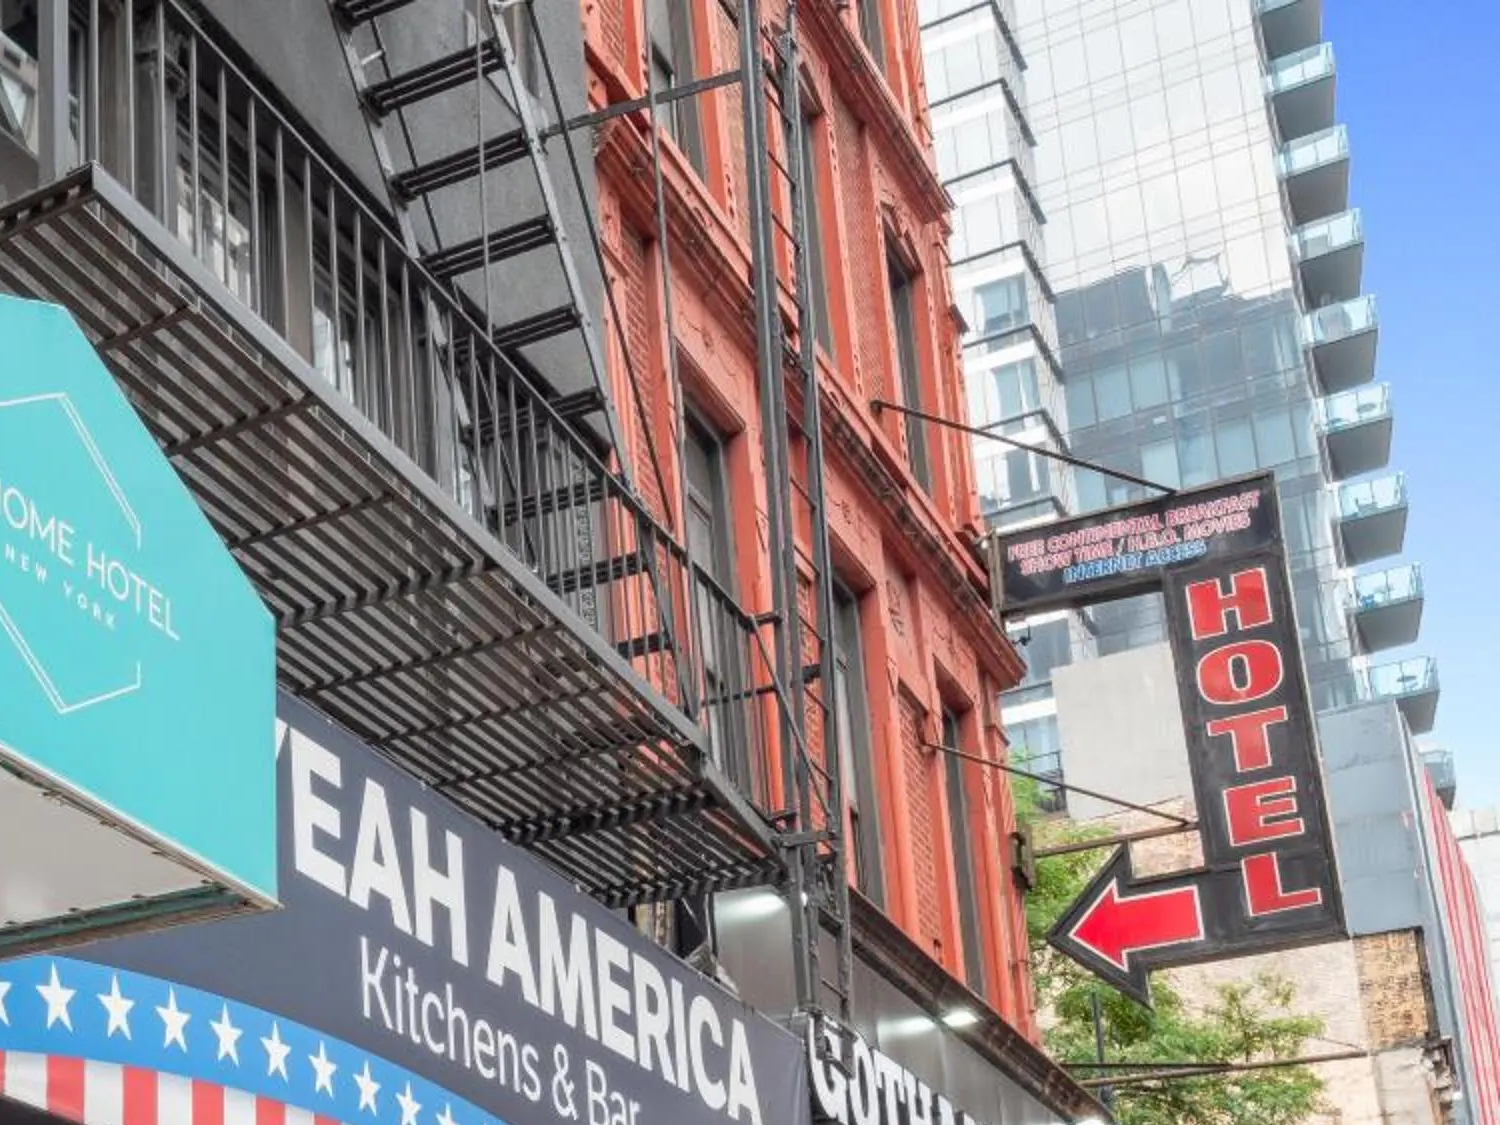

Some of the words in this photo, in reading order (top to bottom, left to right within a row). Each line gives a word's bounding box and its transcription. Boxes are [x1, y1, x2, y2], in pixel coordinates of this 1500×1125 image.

[1047, 513, 1162, 552] CONTINENTAL
[1165, 489, 1261, 527] BREAKFAST
[1062, 556, 1143, 584] INTERNET
[1145, 539, 1208, 567] ACCESS
[1183, 511, 1251, 541] MOVIES
[4, 542, 48, 585] NEW
[62, 580, 116, 630] YORK
[86, 541, 180, 642] HOTEL
[1185, 566, 1323, 918] HOTEL
[276, 718, 470, 968] EAH
[360, 935, 542, 1103] Kitchens
[551, 1043, 578, 1122] &
